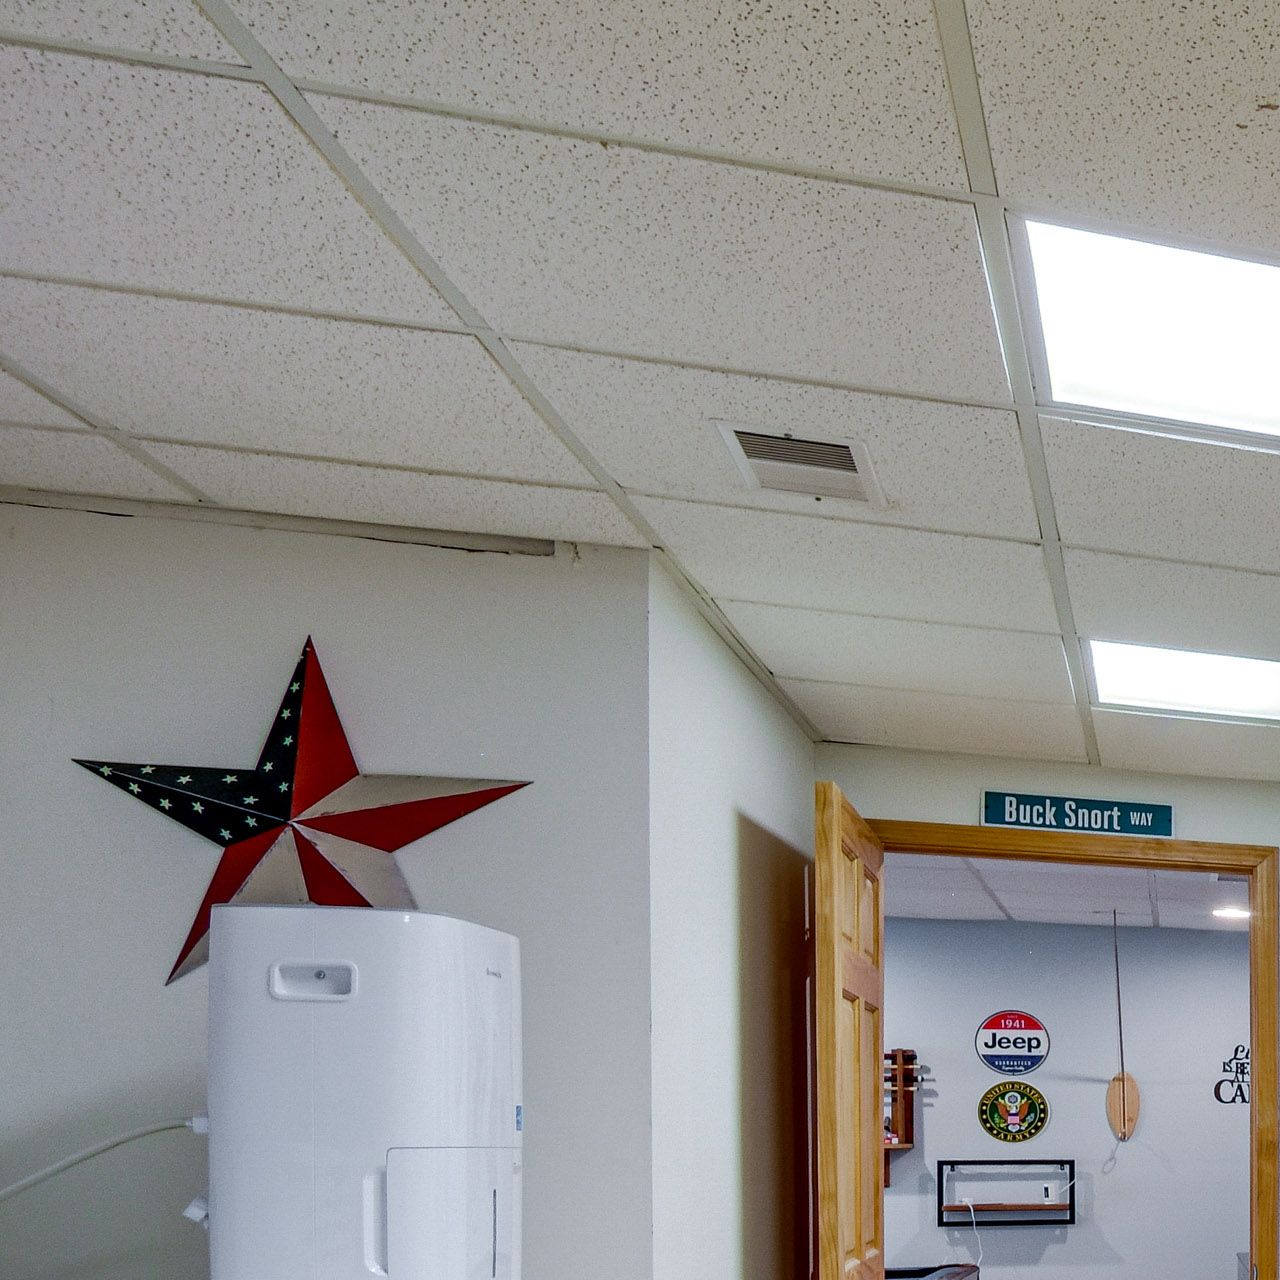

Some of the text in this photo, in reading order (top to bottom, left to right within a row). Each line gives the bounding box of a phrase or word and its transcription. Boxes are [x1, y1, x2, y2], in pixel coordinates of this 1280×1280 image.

[1005, 796, 1153, 831] Buck Snort WAY
[1001, 1019, 1025, 1029] 1941
[984, 1032, 1041, 1053] Jeep
[983, 1083, 1044, 1104] UNITED STATES
[998, 1132, 1030, 1141] ARMY
